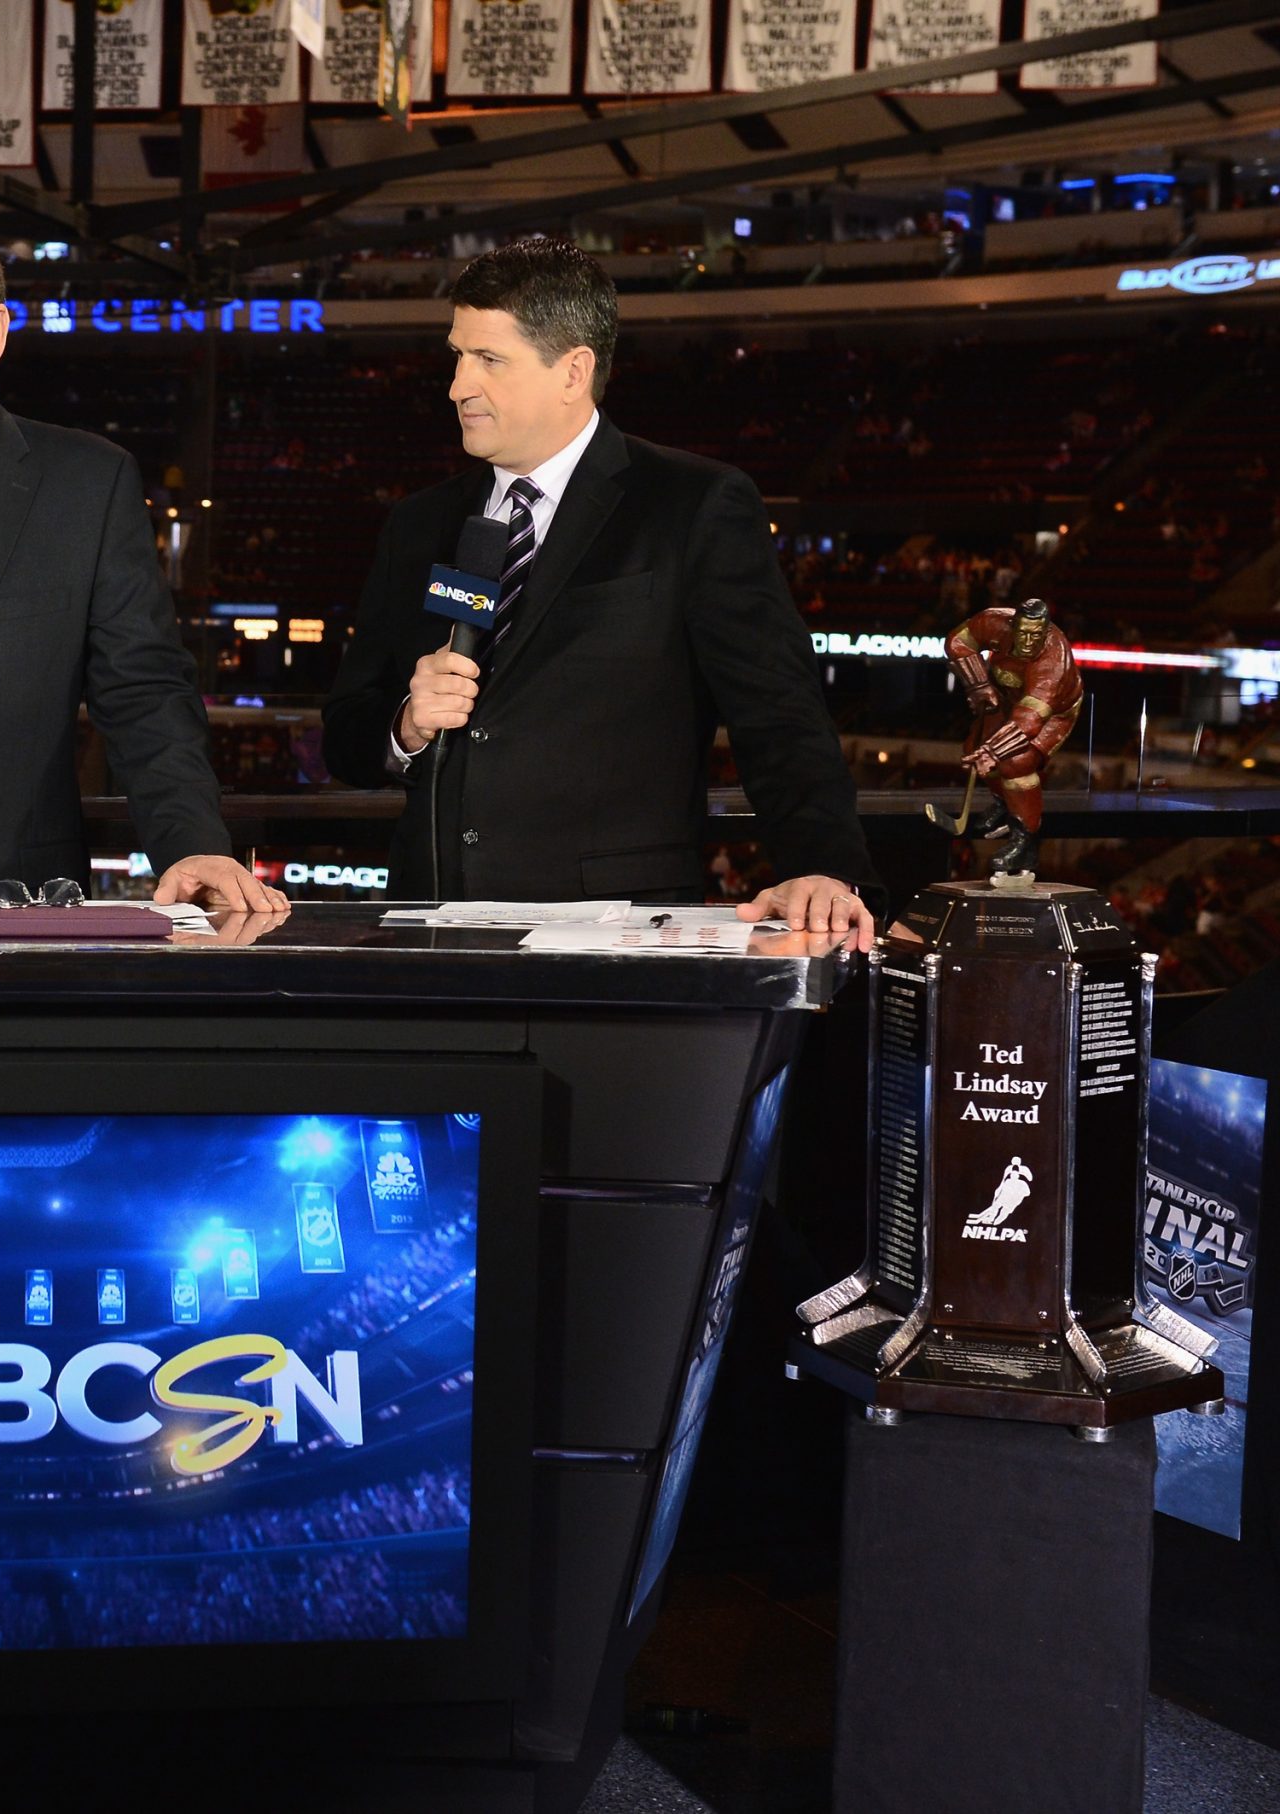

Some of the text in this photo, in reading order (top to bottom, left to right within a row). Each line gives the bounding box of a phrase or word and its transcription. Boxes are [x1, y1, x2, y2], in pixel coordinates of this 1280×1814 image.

[1116, 268, 1171, 291] BUD
[91, 298, 325, 333] CENTER
[446, 586, 495, 612] NBCSN
[979, 1043, 1024, 1065] Ted
[954, 1071, 1048, 1100] Lindsay
[960, 1101, 1040, 1124] Award
[1146, 1172, 1237, 1223] TANLEY CUP
[962, 1224, 1028, 1244] NHLPA
[1146, 1196, 1249, 1269] INAL
[1172, 1267, 1195, 1292] NHL
